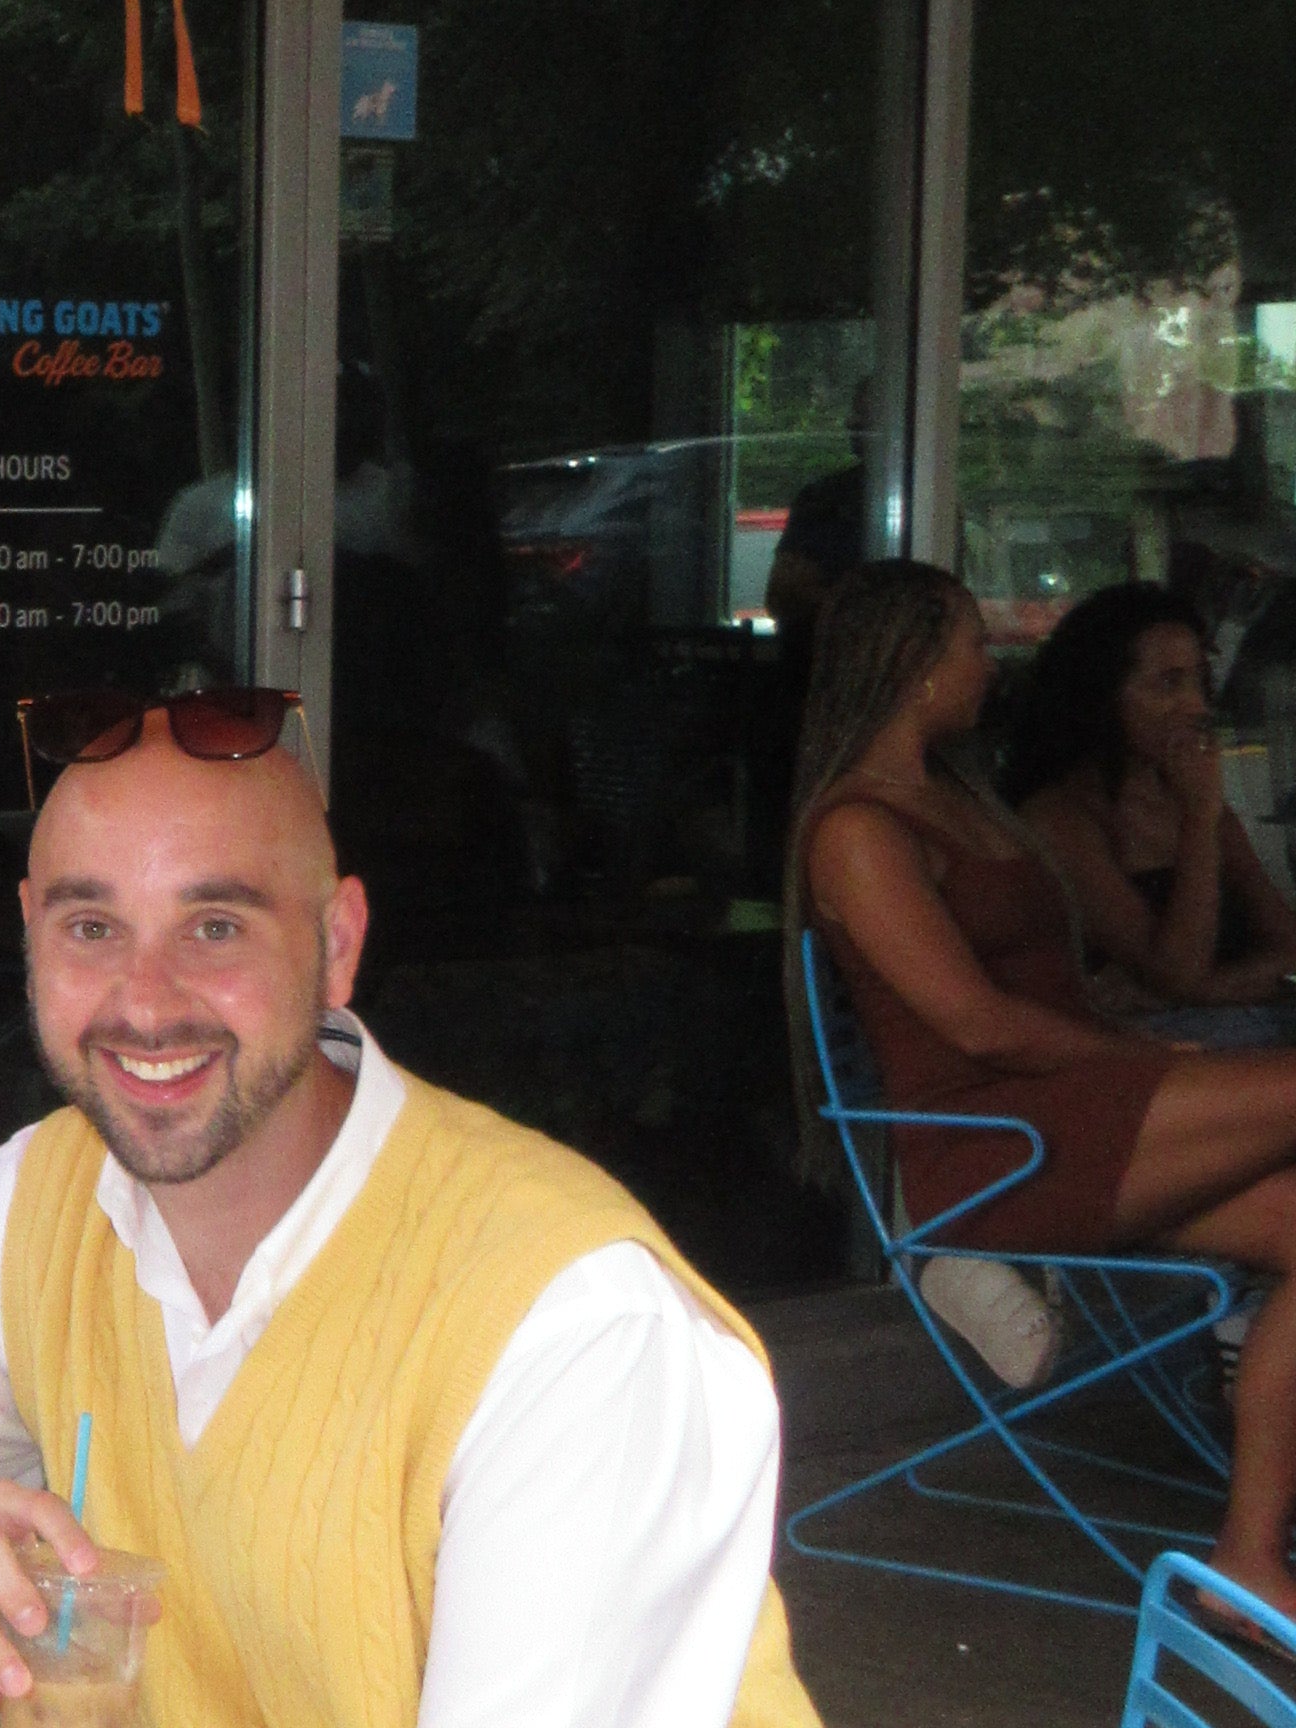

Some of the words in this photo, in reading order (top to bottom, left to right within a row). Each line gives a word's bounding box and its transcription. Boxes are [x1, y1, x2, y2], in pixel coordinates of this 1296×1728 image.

[12, 339, 100, 387] Coffee
[104, 339, 163, 379] Bar
[16, 551, 48, 570] am
[72, 544, 123, 568] 7:00
[127, 549, 159, 573] pm
[15, 609, 48, 628] am
[72, 602, 122, 627] 7:00
[126, 606, 159, 630] pm
